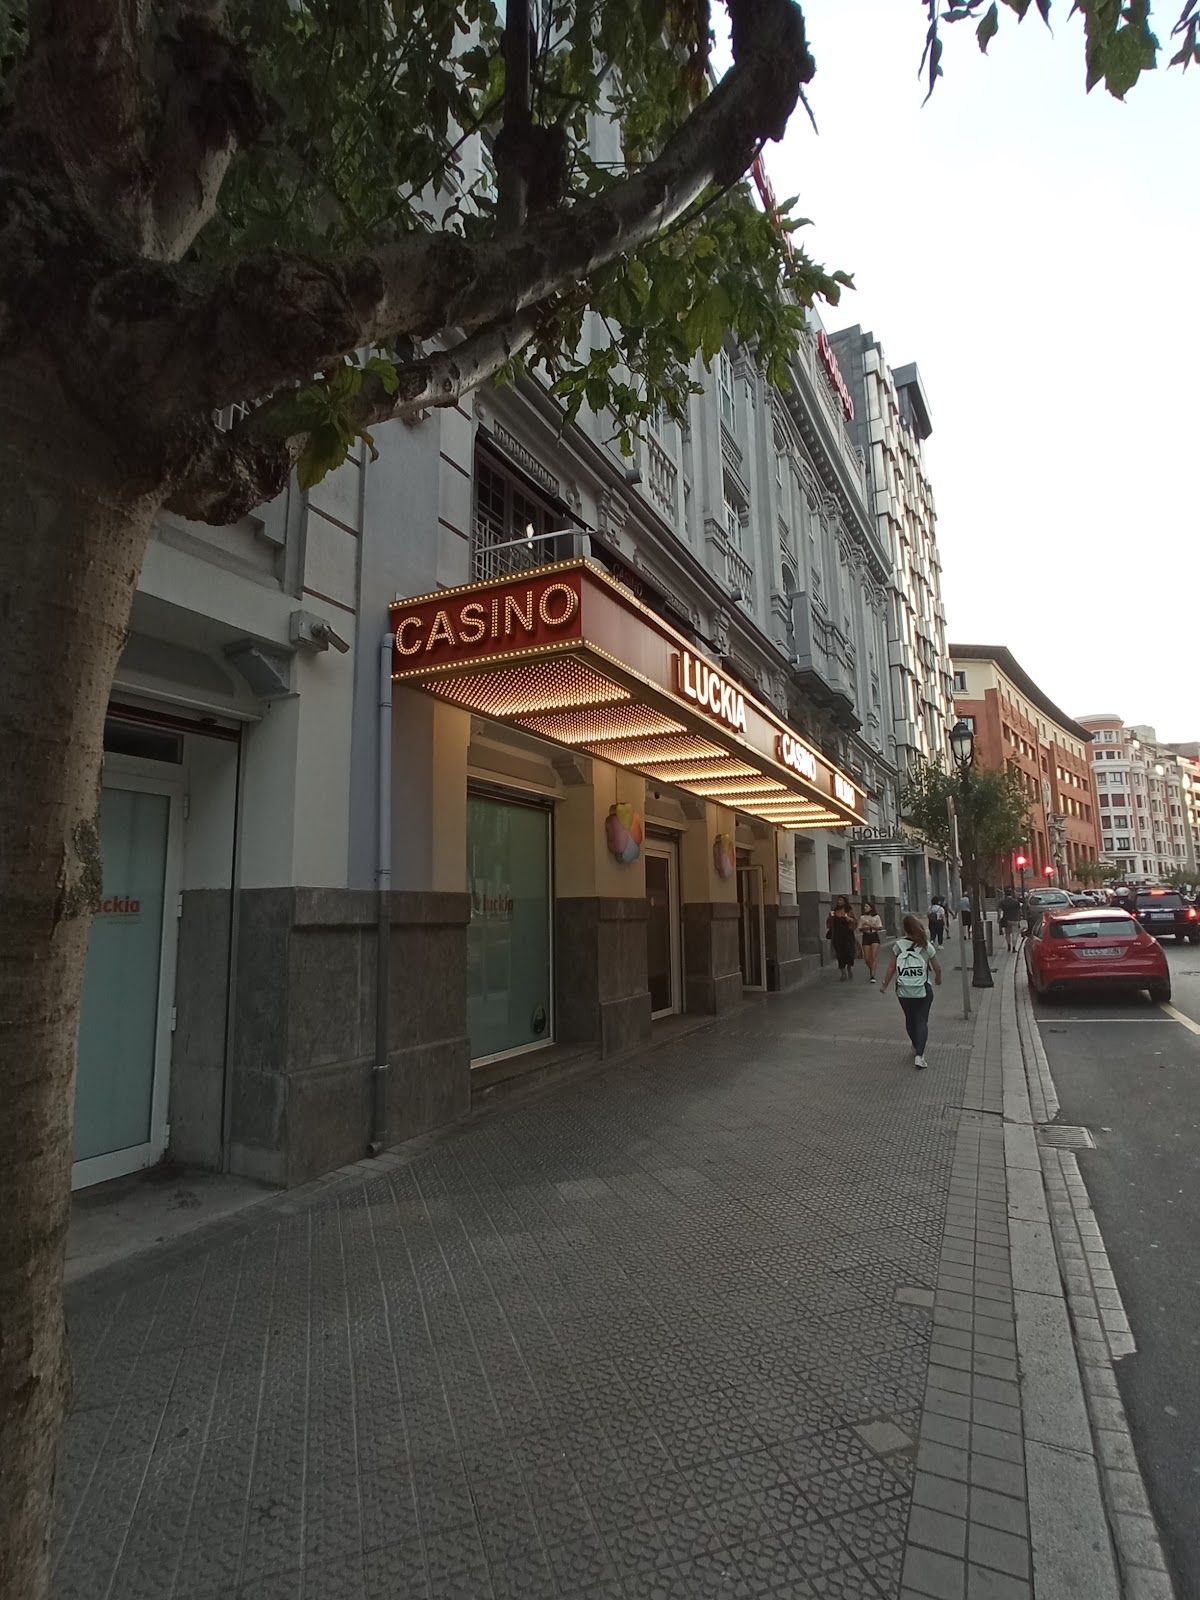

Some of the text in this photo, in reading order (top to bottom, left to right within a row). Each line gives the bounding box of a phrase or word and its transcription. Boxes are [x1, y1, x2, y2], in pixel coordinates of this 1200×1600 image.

[395, 583, 576, 656] CASINO
[682, 651, 748, 734] LUCKIA
[782, 733, 817, 782] CASINO
[852, 826, 892, 840] Hotel
[897, 966, 924, 977] VANS
